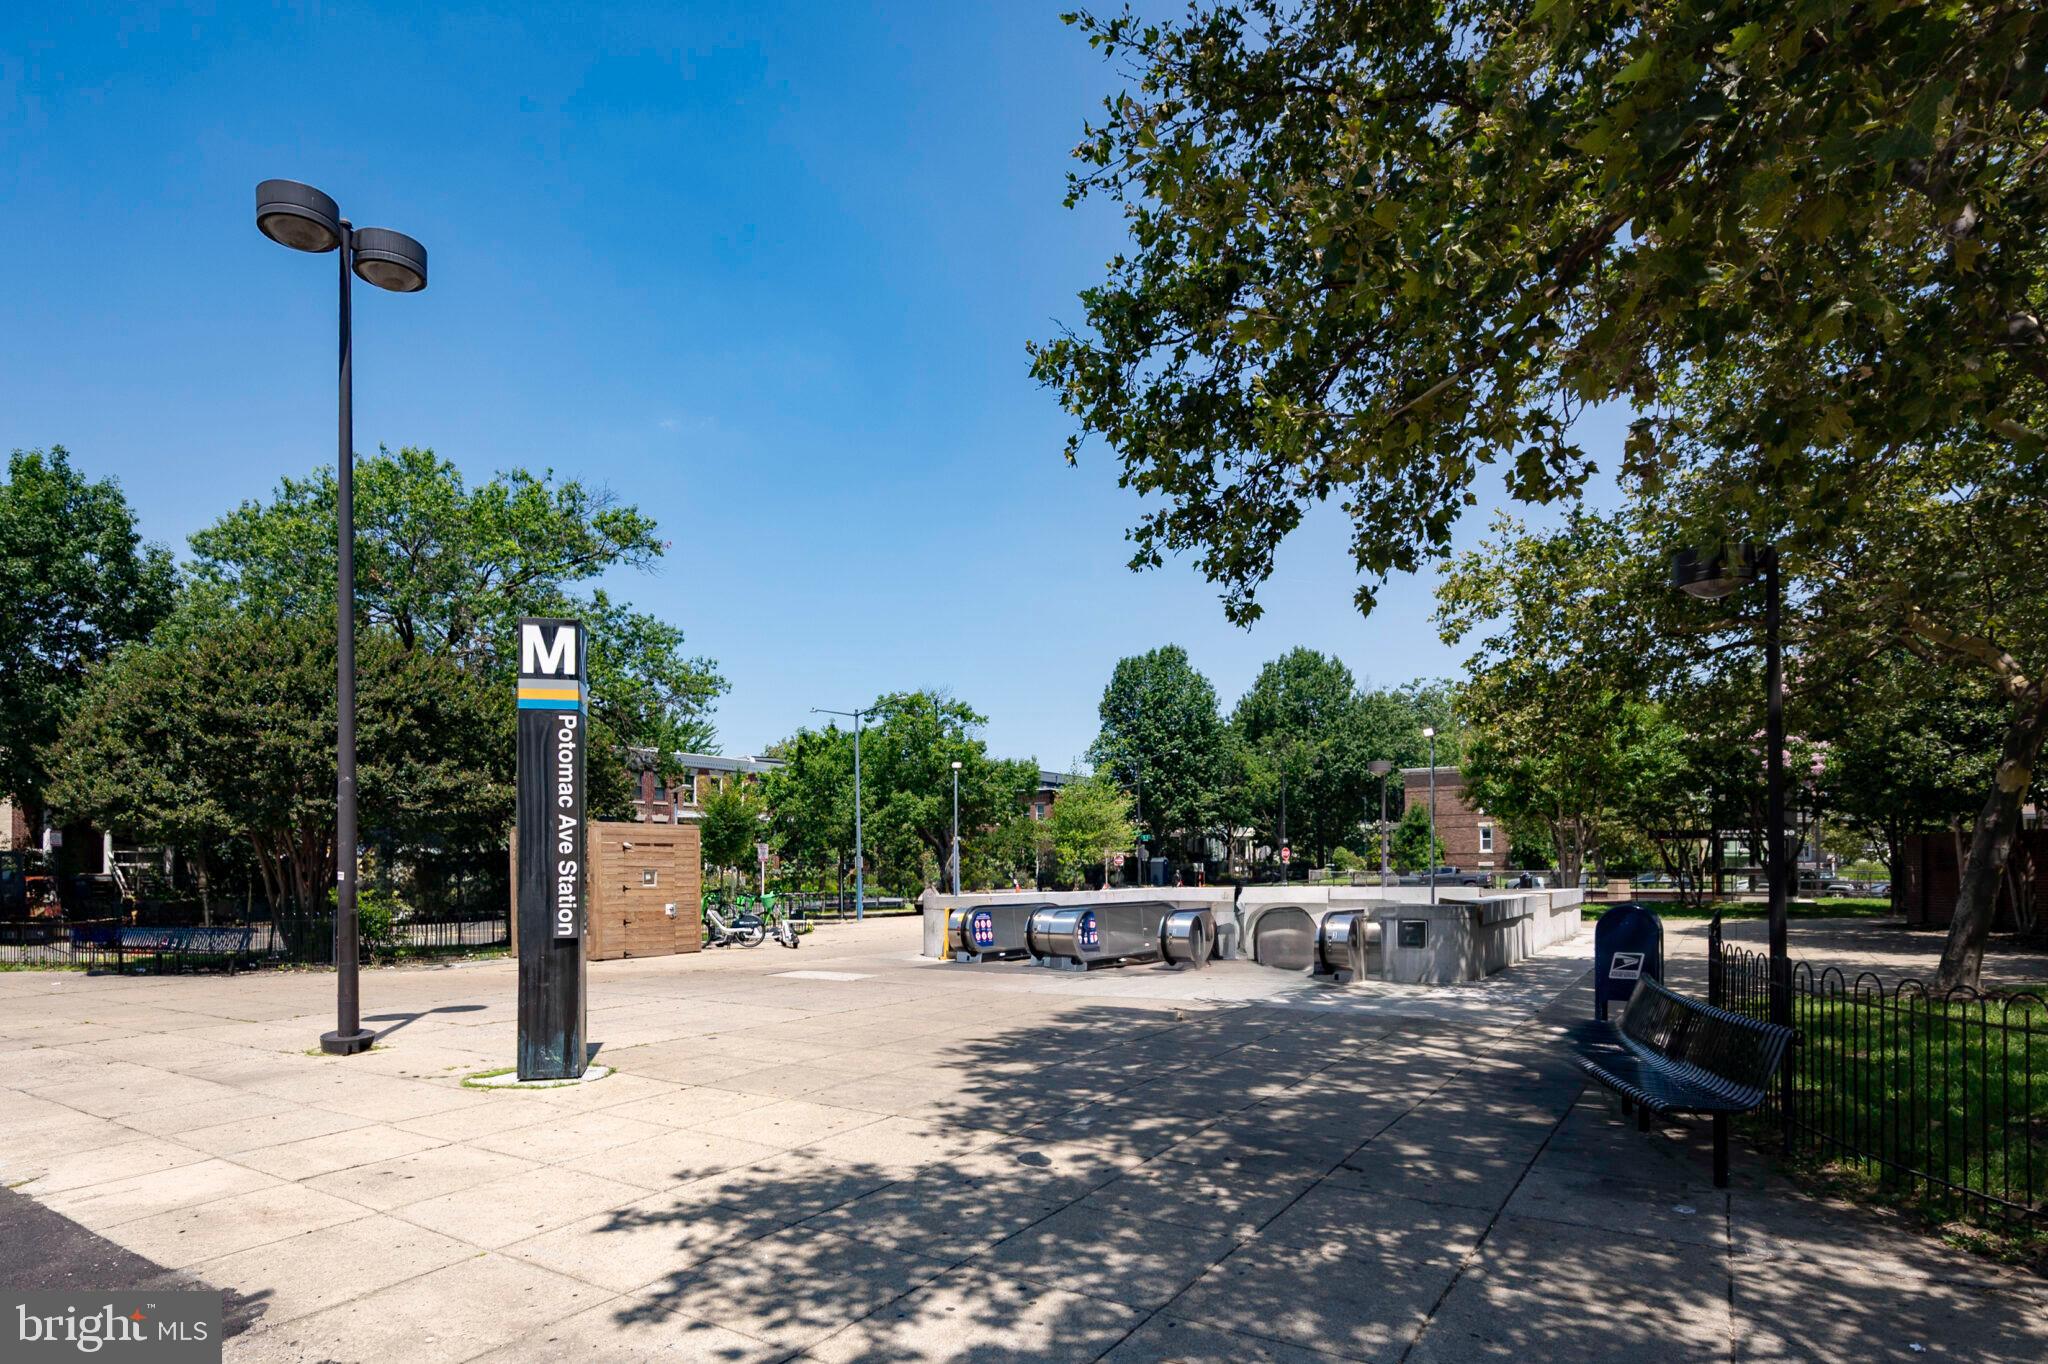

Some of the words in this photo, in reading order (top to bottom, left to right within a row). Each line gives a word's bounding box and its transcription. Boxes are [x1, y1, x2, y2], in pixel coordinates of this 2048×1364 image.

[522, 624, 576, 675] M
[558, 715, 577, 808] Potomac
[558, 814, 577, 854] Ave
[558, 860, 578, 936] Station
